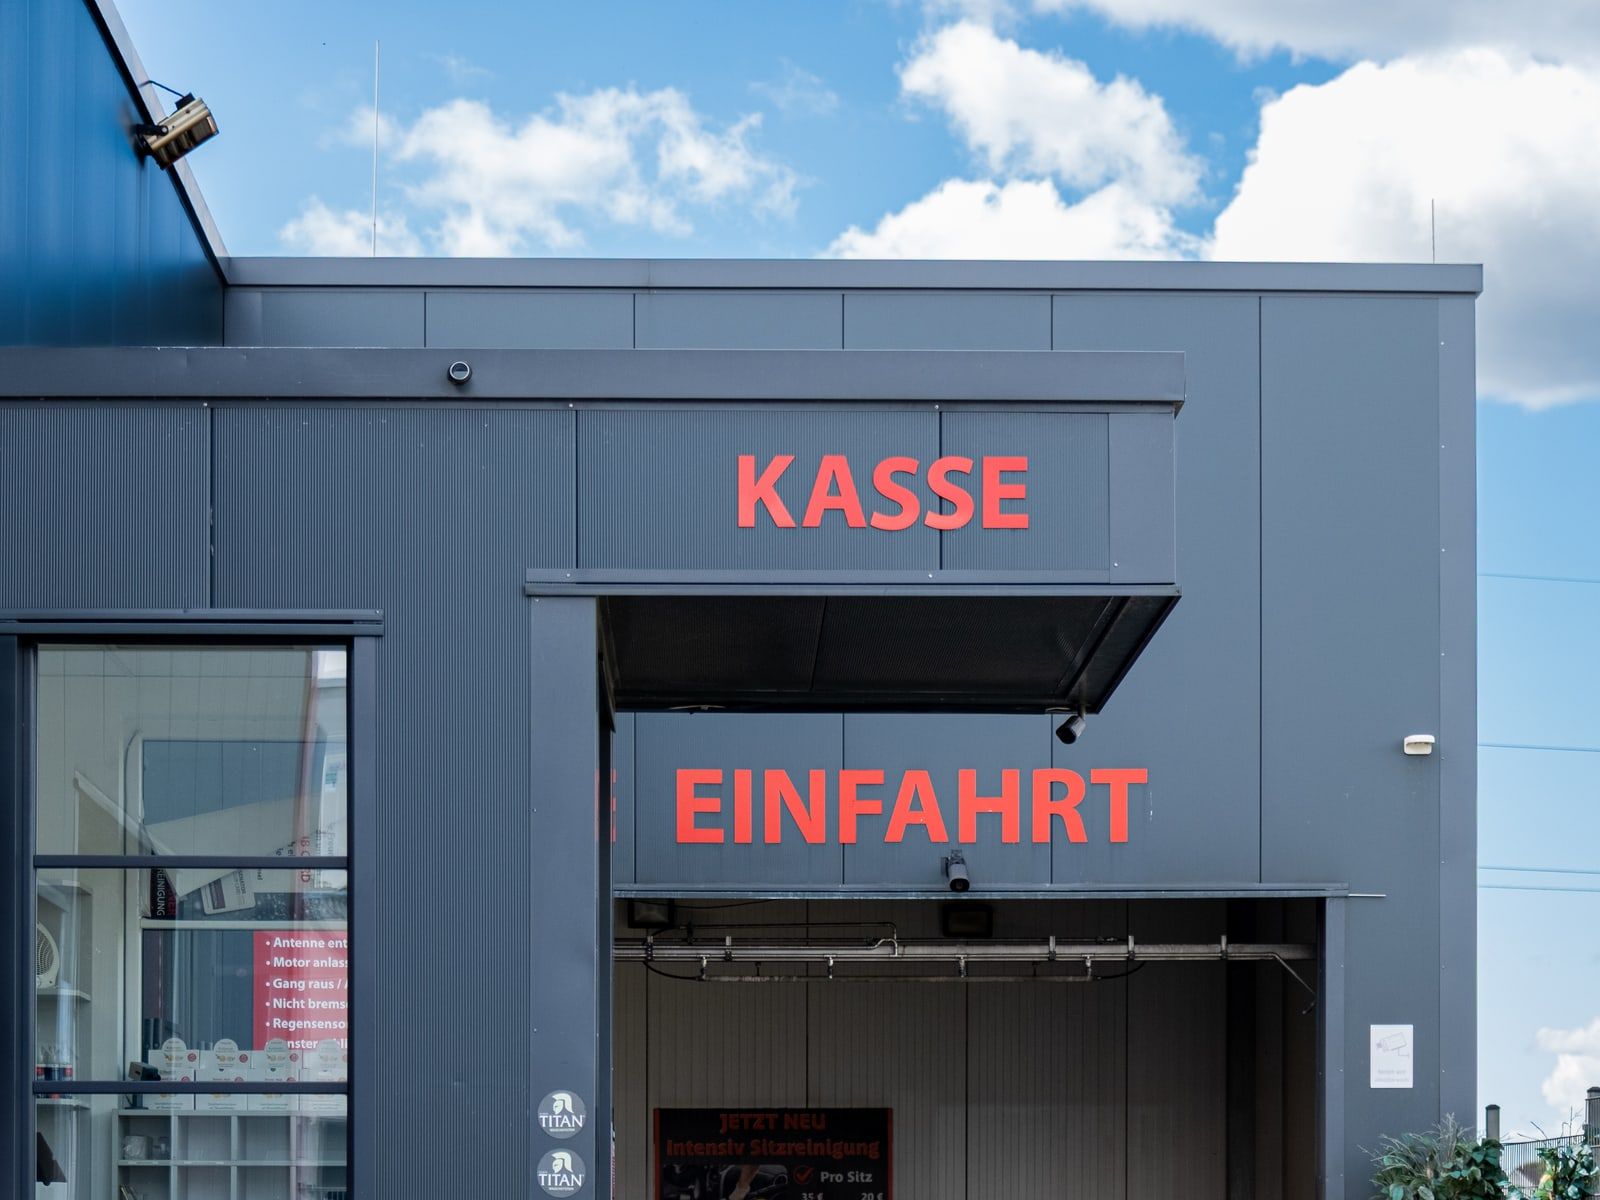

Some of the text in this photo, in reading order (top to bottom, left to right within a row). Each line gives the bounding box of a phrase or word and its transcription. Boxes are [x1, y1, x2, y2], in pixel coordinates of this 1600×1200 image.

[738, 455, 1029, 531] KASSE
[676, 768, 1148, 844] EINFAHRT
[273, 937, 325, 948] Antenne
[273, 957, 310, 968] Motor
[273, 978, 305, 991] Gang
[308, 980, 335, 989] raus
[273, 998, 348, 1009] Nicht brems
[538, 1115, 583, 1128] TITAN
[720, 1114, 826, 1135] JETZT NEU
[666, 1138, 880, 1160] Intensiv Sitzreinigung
[538, 1173, 583, 1187] TITAN
[820, 1170, 873, 1183] Pro Sitz
